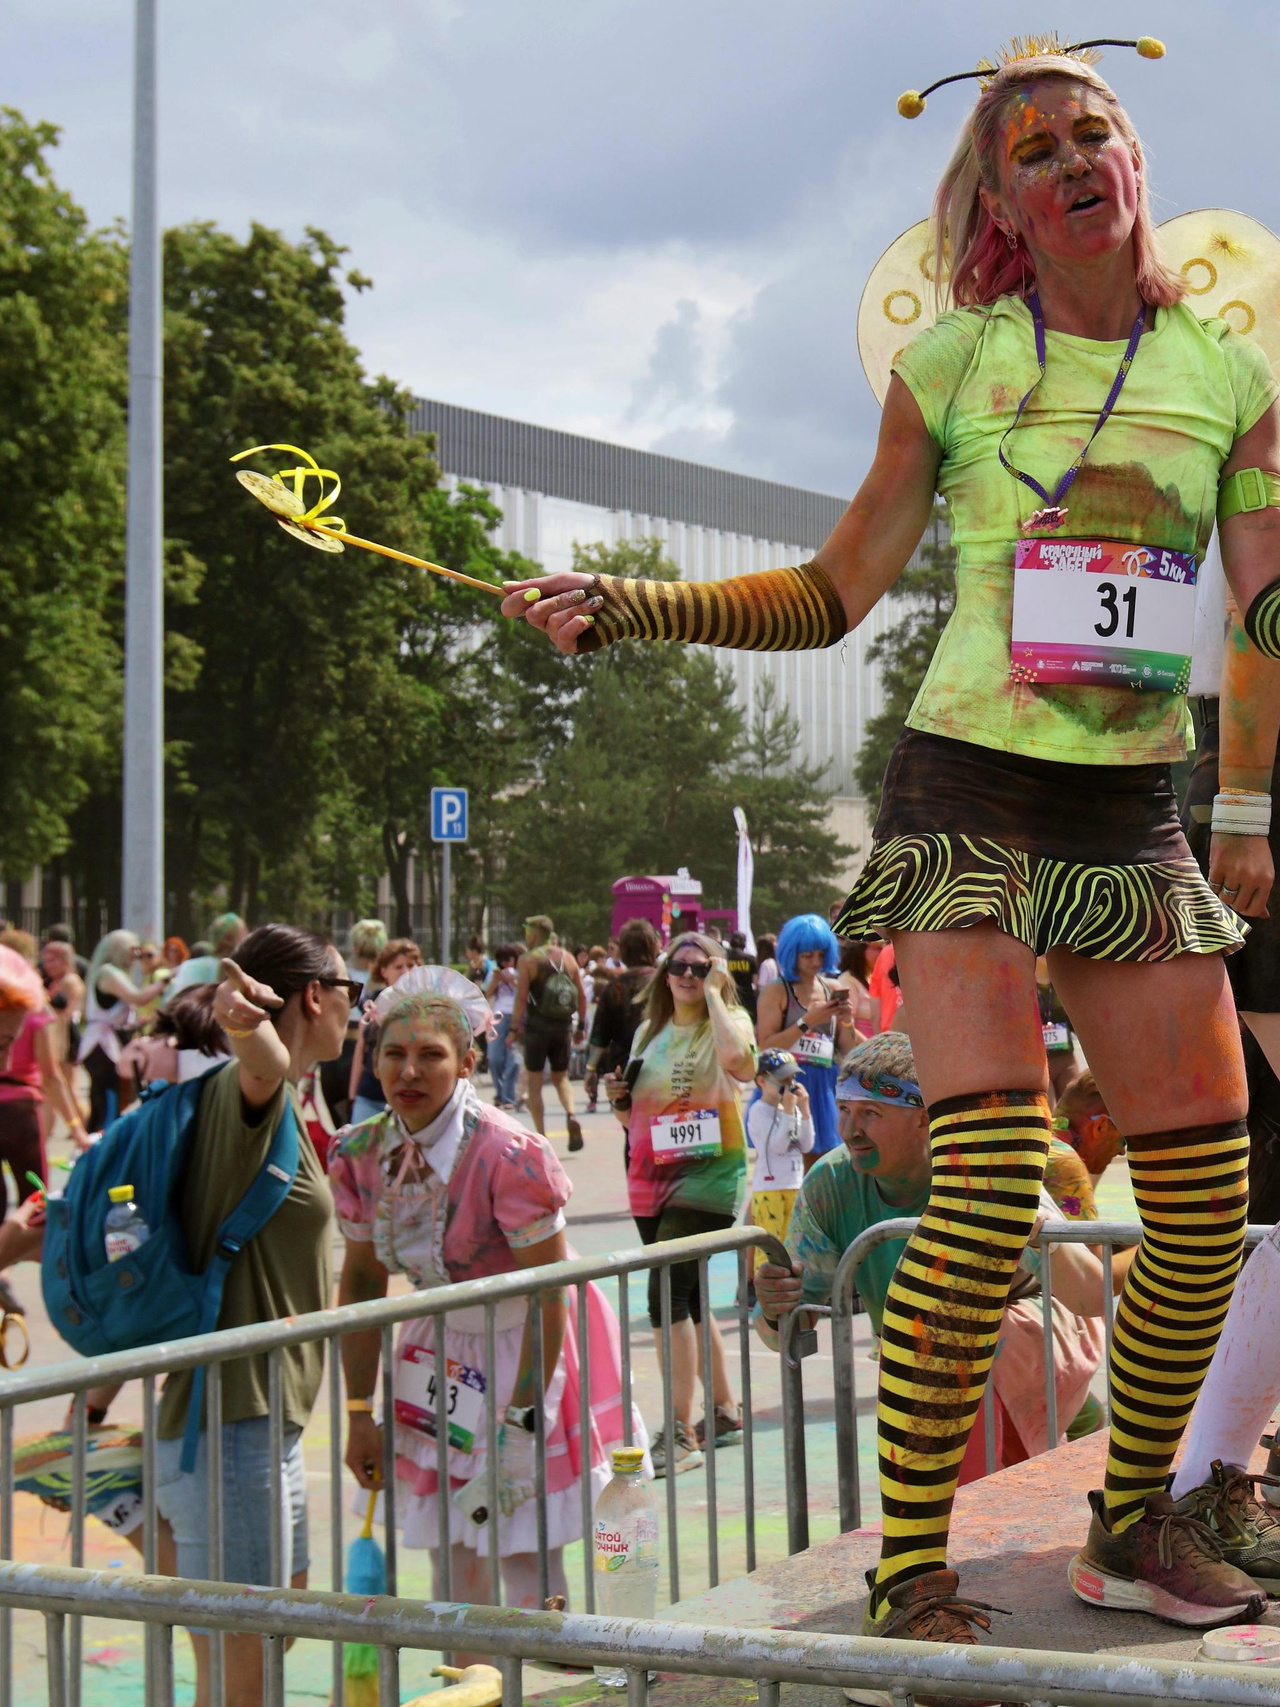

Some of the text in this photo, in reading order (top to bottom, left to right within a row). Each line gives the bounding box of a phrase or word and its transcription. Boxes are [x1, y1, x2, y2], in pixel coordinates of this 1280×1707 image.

[1039, 544, 1103, 560] КРАСОЧНЫЙ
[1050, 557, 1092, 573] ЗАБЕГ
[1094, 582, 1137, 638] 31
[441, 794, 462, 836] P
[799, 1038, 822, 1054] 4767
[670, 1123, 702, 1144] 4991
[427, 1375, 459, 1415] 43
